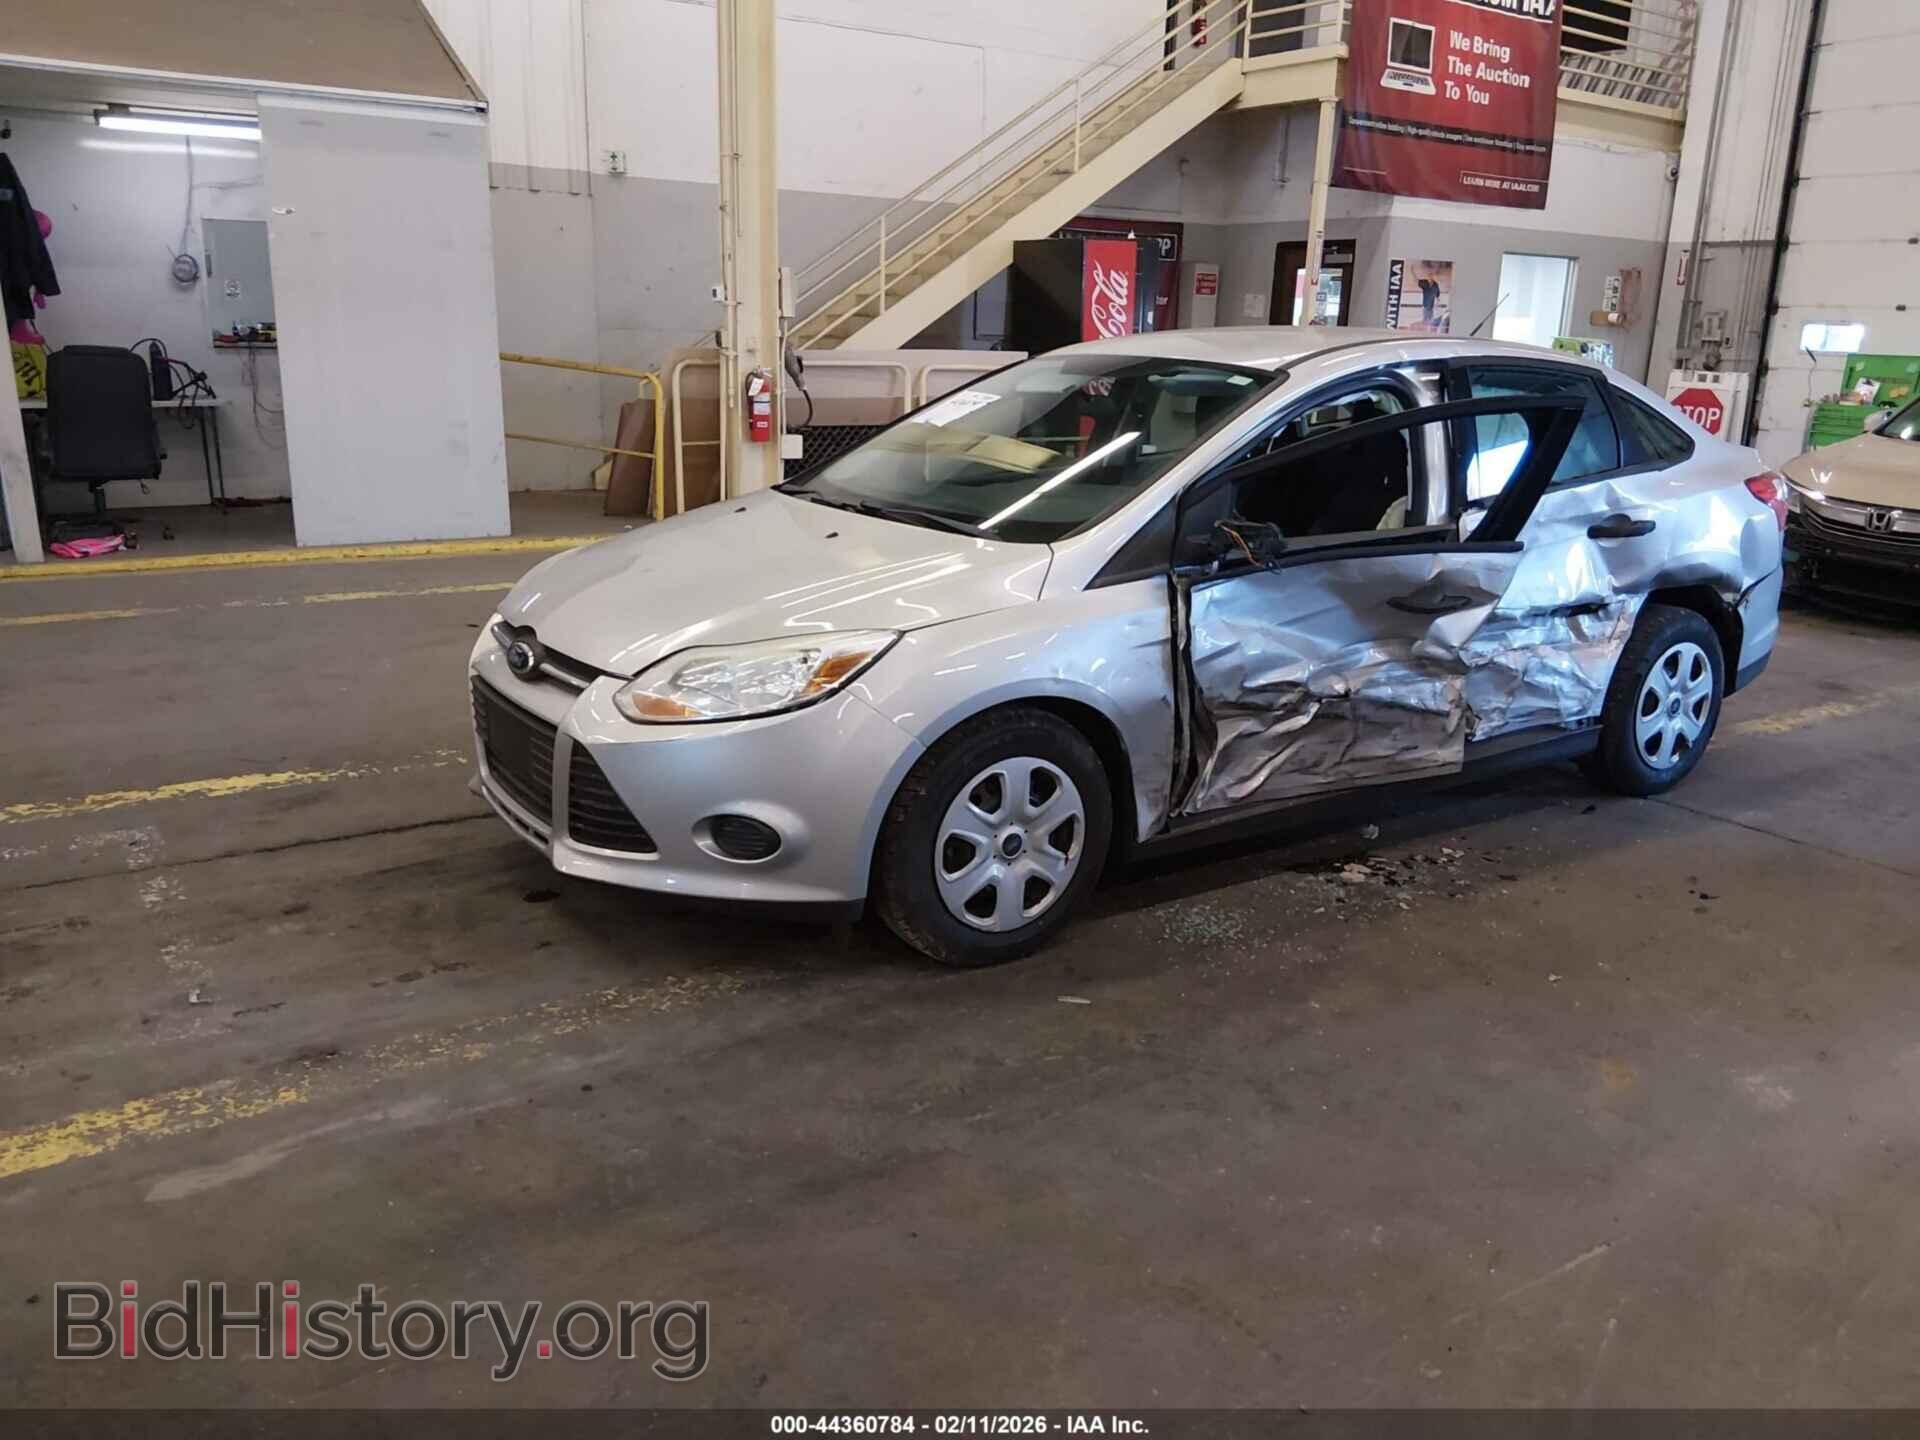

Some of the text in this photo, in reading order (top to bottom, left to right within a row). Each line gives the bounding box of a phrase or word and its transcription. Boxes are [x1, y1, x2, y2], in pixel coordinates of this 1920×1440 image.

[1450, 30, 1510, 63] We Bring
[1447, 55, 1530, 88] The Auction
[1444, 80, 1490, 105] To You
[1391, 263, 1402, 289] IAA
[1676, 405, 1720, 429] TOP
